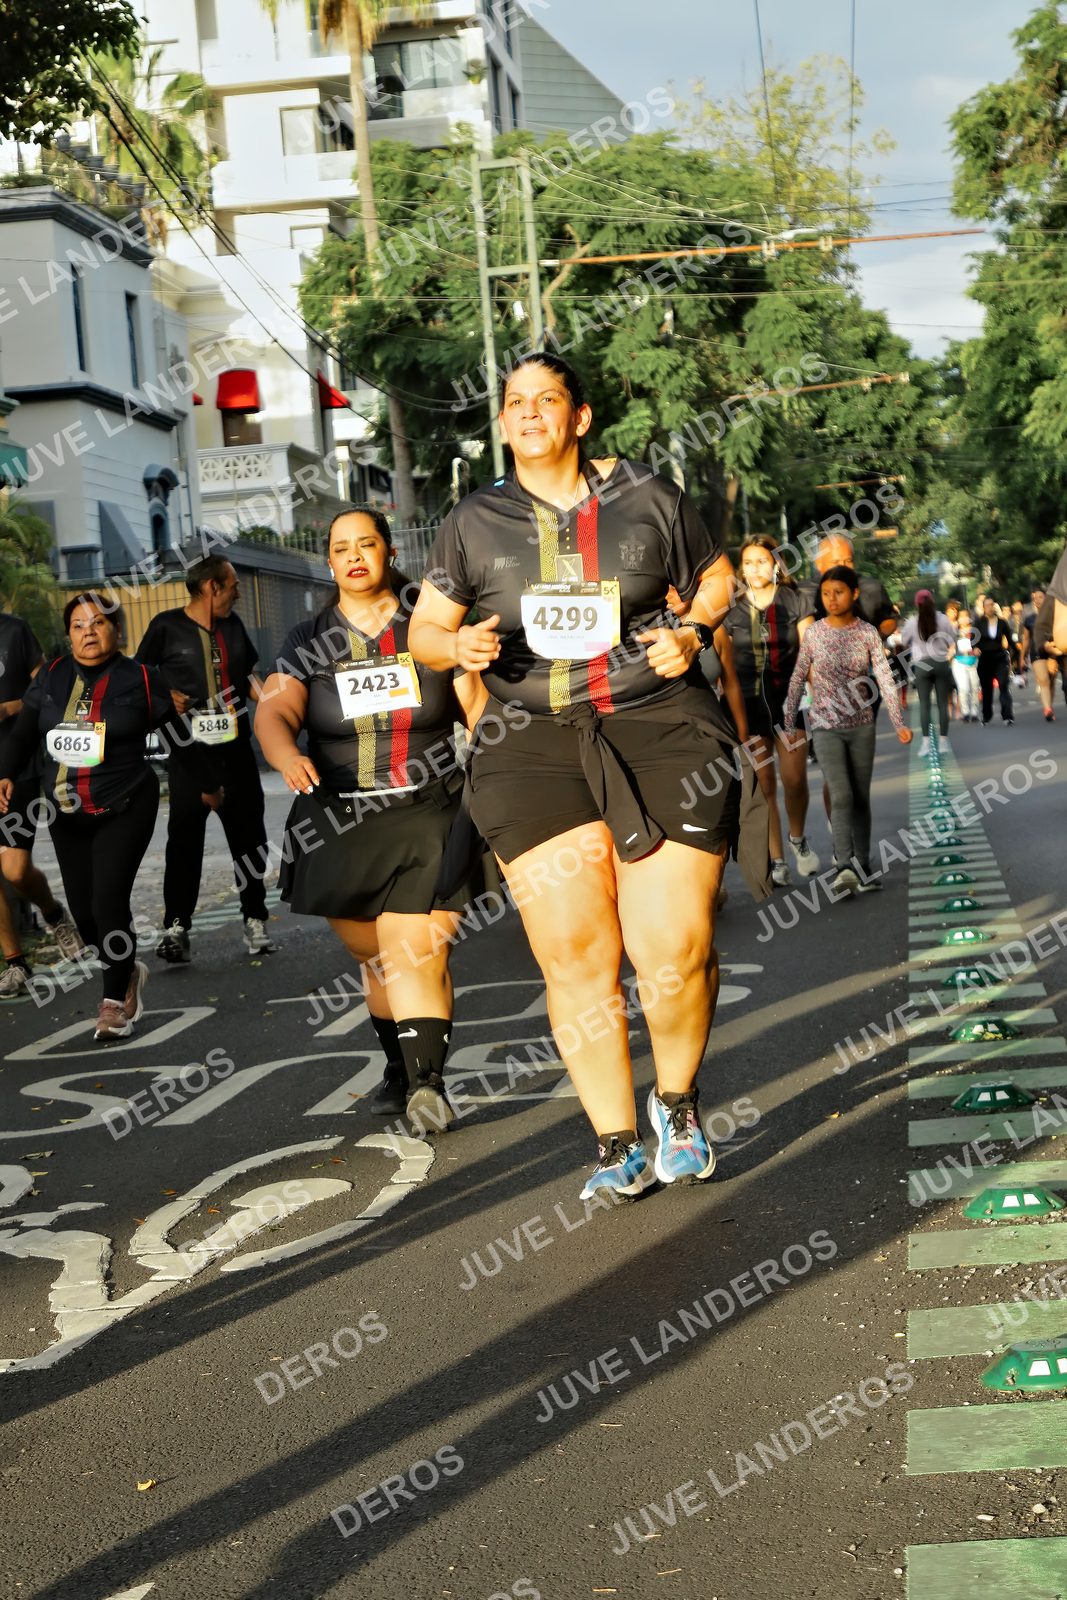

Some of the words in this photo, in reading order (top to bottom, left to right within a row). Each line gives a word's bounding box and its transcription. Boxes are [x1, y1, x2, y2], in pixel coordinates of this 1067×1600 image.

[533, 606, 598, 631] 4299
[347, 672, 400, 695] 2423
[199, 718, 229, 732] 5848
[53, 736, 91, 752] 6865
